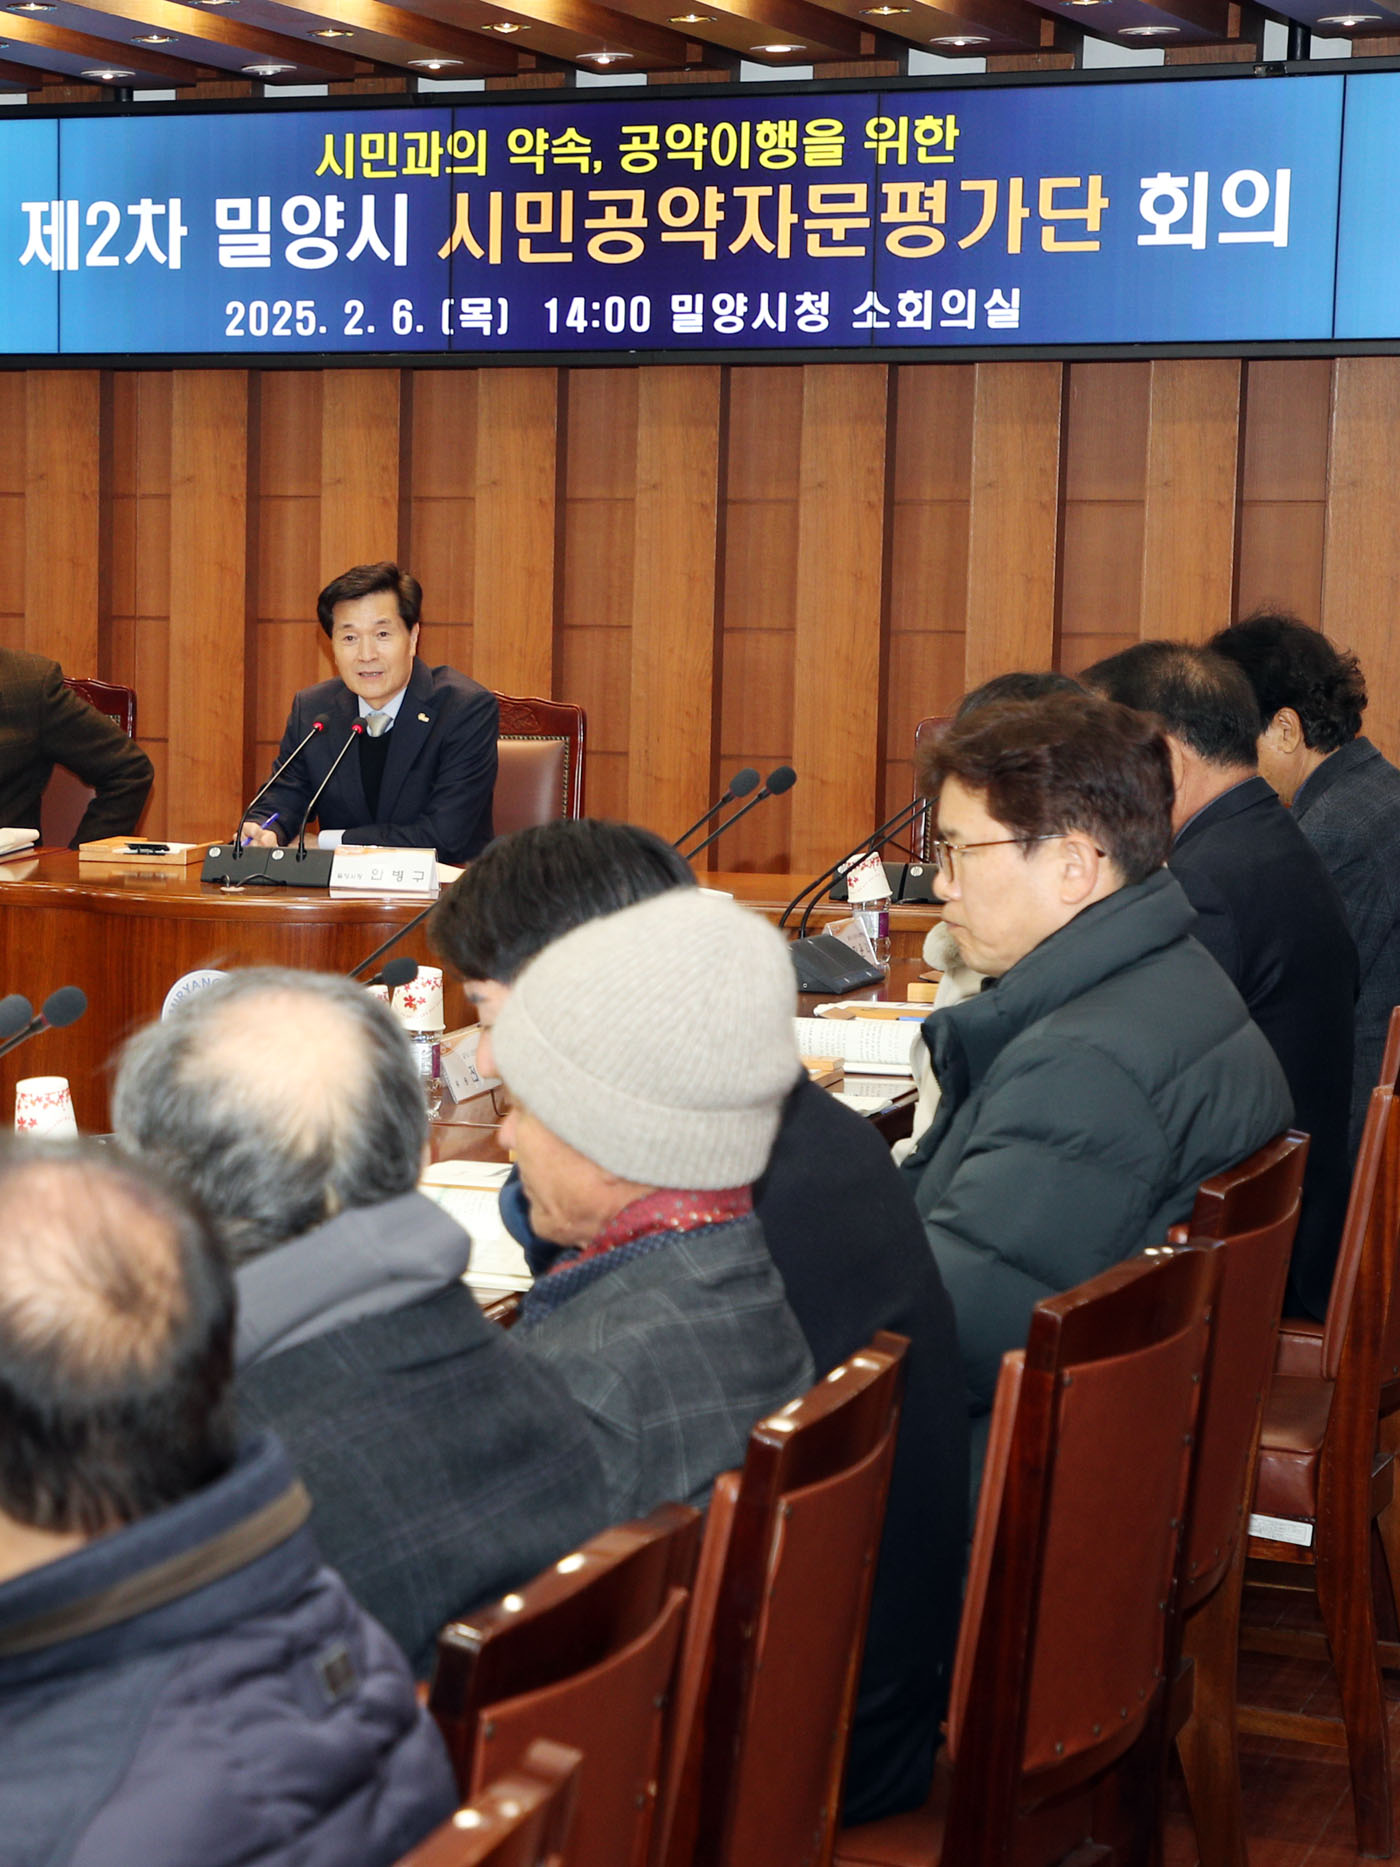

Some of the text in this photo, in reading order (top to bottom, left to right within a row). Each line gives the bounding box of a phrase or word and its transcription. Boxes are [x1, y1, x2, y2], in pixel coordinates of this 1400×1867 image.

[315, 114, 960, 179] 시민과의 약속, 공약이행을 위한
[18, 167, 1292, 272] 제2차 밀양시 시민공약자문평가단 회의
[225, 300, 327, 337] 2025.
[344, 299, 376, 335] 2.
[392, 299, 425, 335] 6.
[544, 295, 652, 333] 14:00
[670, 291, 831, 334] 밀양시청
[852, 287, 1022, 330] 소회의실
